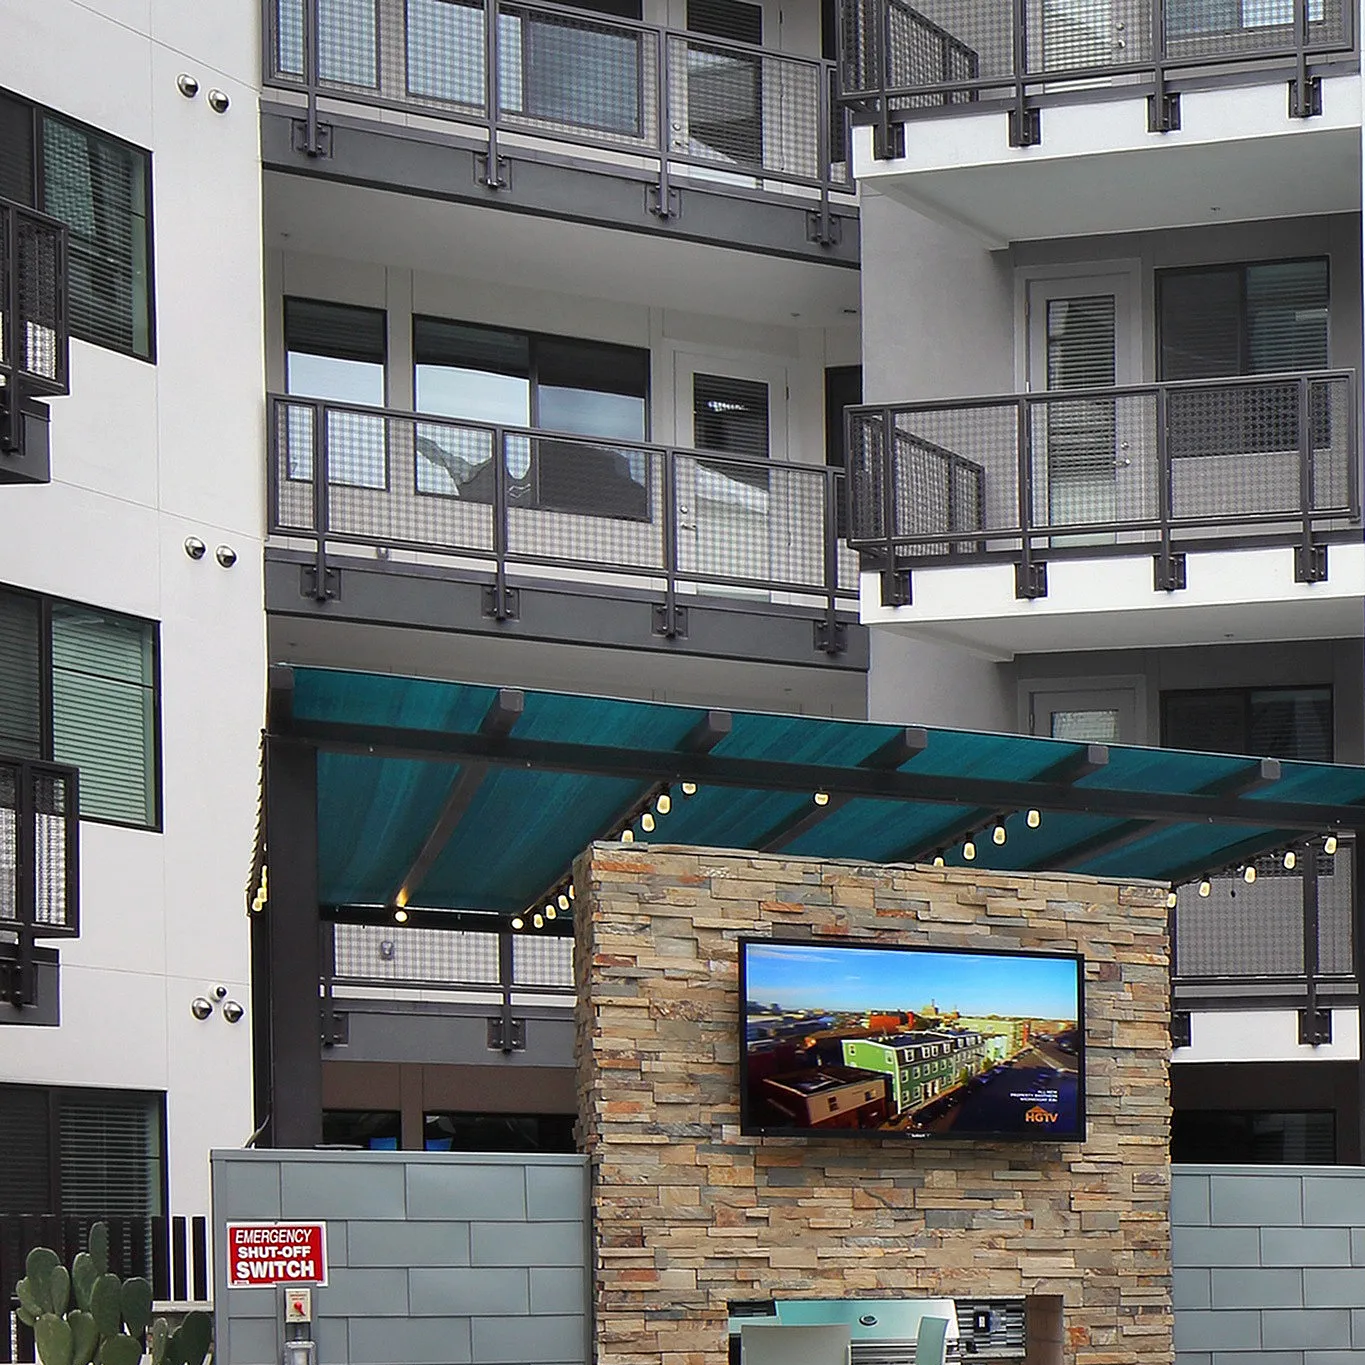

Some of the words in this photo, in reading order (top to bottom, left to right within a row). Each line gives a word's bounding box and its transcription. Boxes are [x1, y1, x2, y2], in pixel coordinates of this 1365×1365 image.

[1025, 1112, 1058, 1122] HGTV
[235, 1229, 312, 1244] EMERGENCY
[238, 1246, 311, 1259] SHUT-OFF
[236, 1260, 315, 1279] SWITCH
